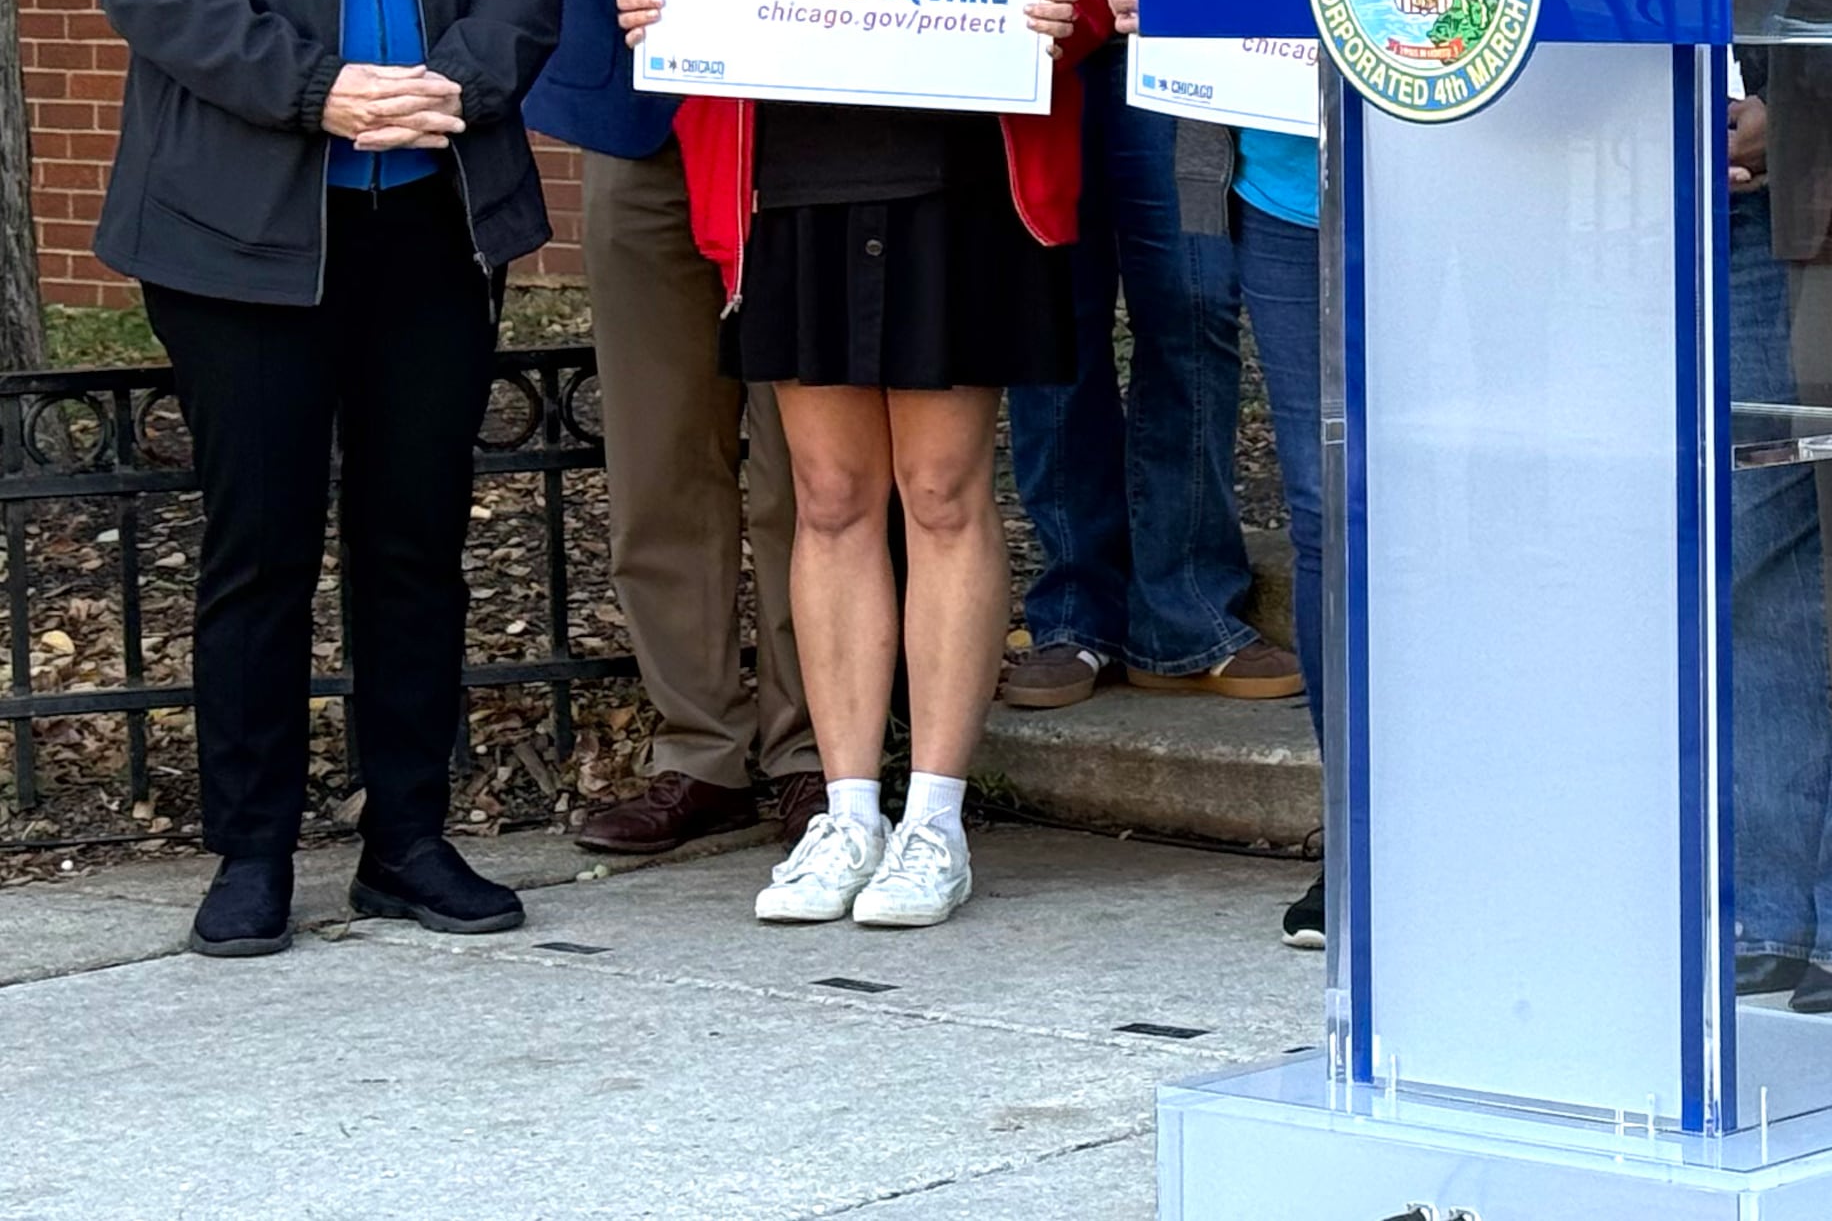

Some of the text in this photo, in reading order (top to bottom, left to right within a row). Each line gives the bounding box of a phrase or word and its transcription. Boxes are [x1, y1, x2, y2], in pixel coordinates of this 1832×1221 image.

[758, 1, 1006, 34] chicago.gov/protect
[1433, 77, 1469, 105] 4th
[1471, 1, 1529, 89] MARCH
[1171, 80, 1213, 99] CHICAGO
